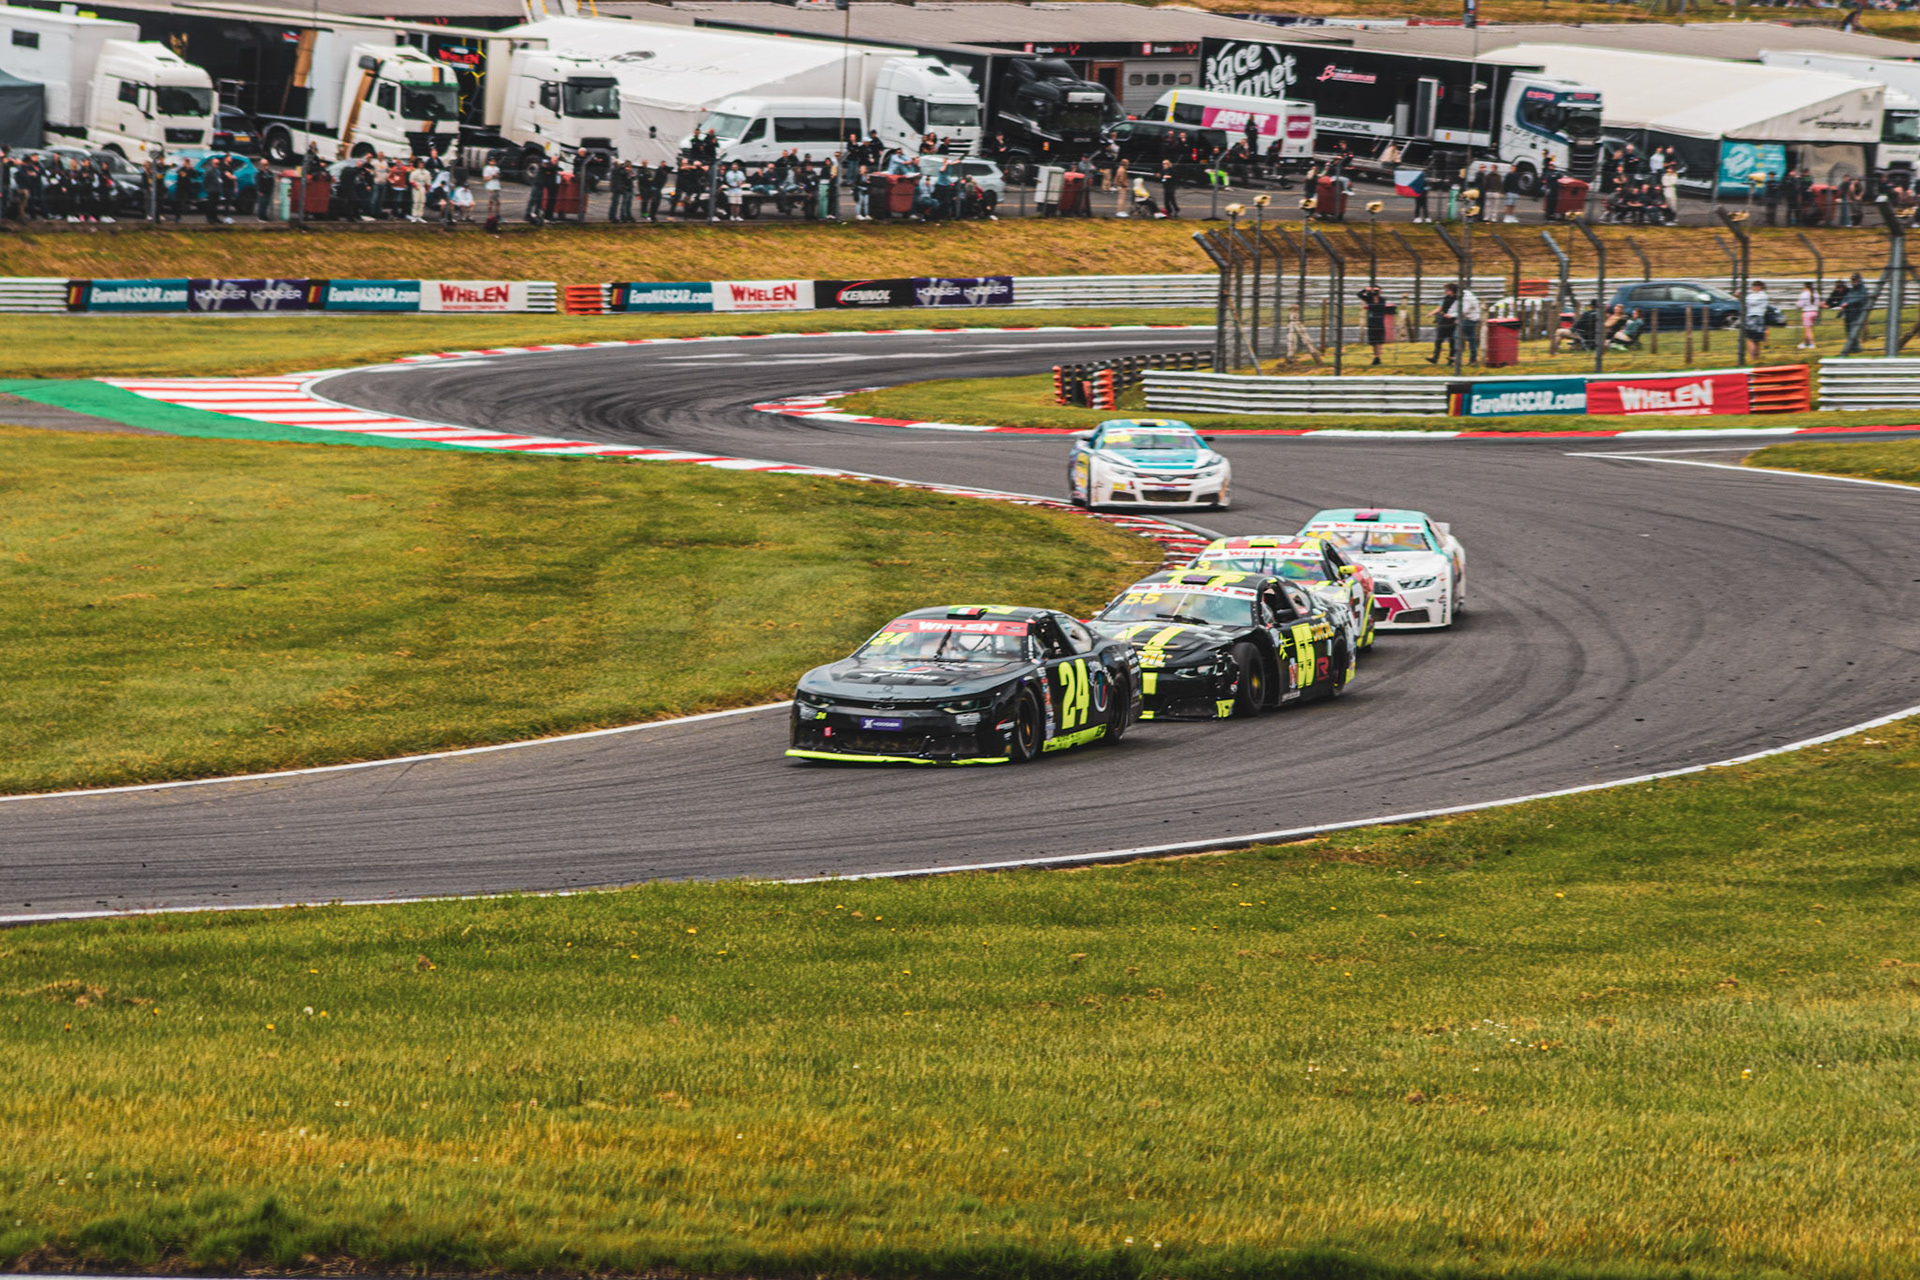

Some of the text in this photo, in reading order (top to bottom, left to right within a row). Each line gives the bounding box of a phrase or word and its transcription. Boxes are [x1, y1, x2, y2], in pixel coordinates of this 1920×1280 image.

[1211, 110, 1271, 130] ARNT
[91, 287, 188, 304] EuroNASCAR.com
[328, 287, 419, 303] EuroNASCAR.com
[439, 283, 509, 302] WHELEN
[629, 289, 714, 304] EuroNASCAR.com
[730, 283, 797, 302] WHELEN
[841, 289, 891, 301] KENNOL
[1471, 391, 1587, 415] EuroNASCAR.com
[1617, 379, 1714, 411] WHELEN
[1158, 583, 1229, 593] WHELEN
[1122, 593, 1163, 605] 55
[918, 621, 1000, 632] WHELEN
[870, 631, 911, 646] 24
[1058, 658, 1090, 730] 24
